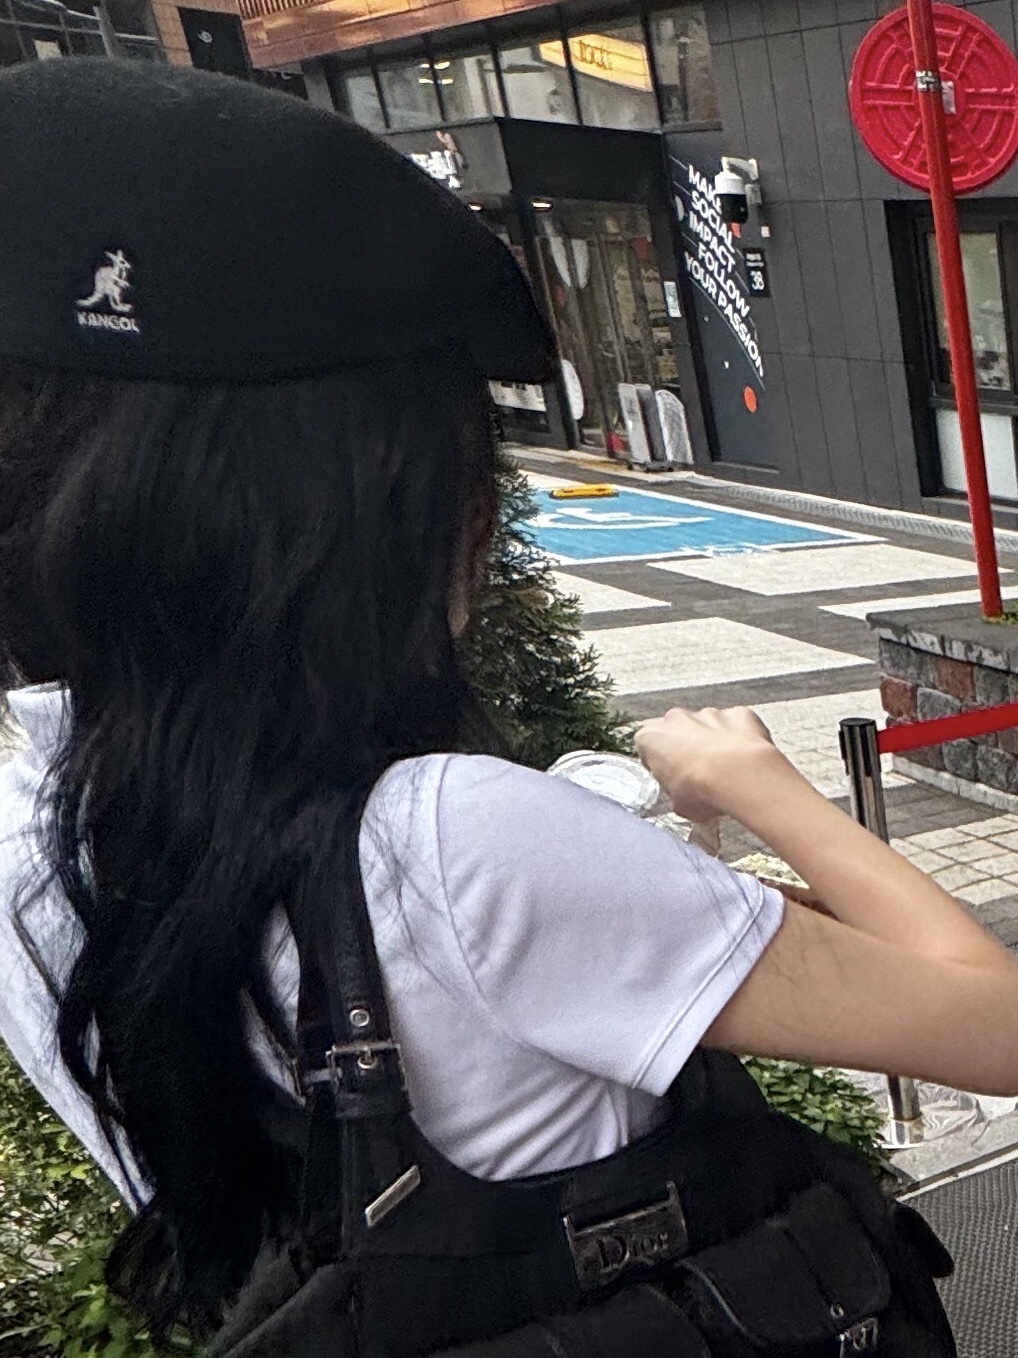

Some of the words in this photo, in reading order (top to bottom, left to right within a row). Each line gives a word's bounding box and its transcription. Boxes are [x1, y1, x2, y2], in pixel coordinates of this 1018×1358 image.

[689, 210, 736, 273] IMPACT
[691, 190, 735, 254] SOCIAL
[698, 241, 750, 317] FOLLOW
[77, 311, 140, 333] KANGOL
[684, 251, 717, 300] YOUR
[717, 290, 764, 378] PASSION
[595, 1232, 670, 1274] Dior
